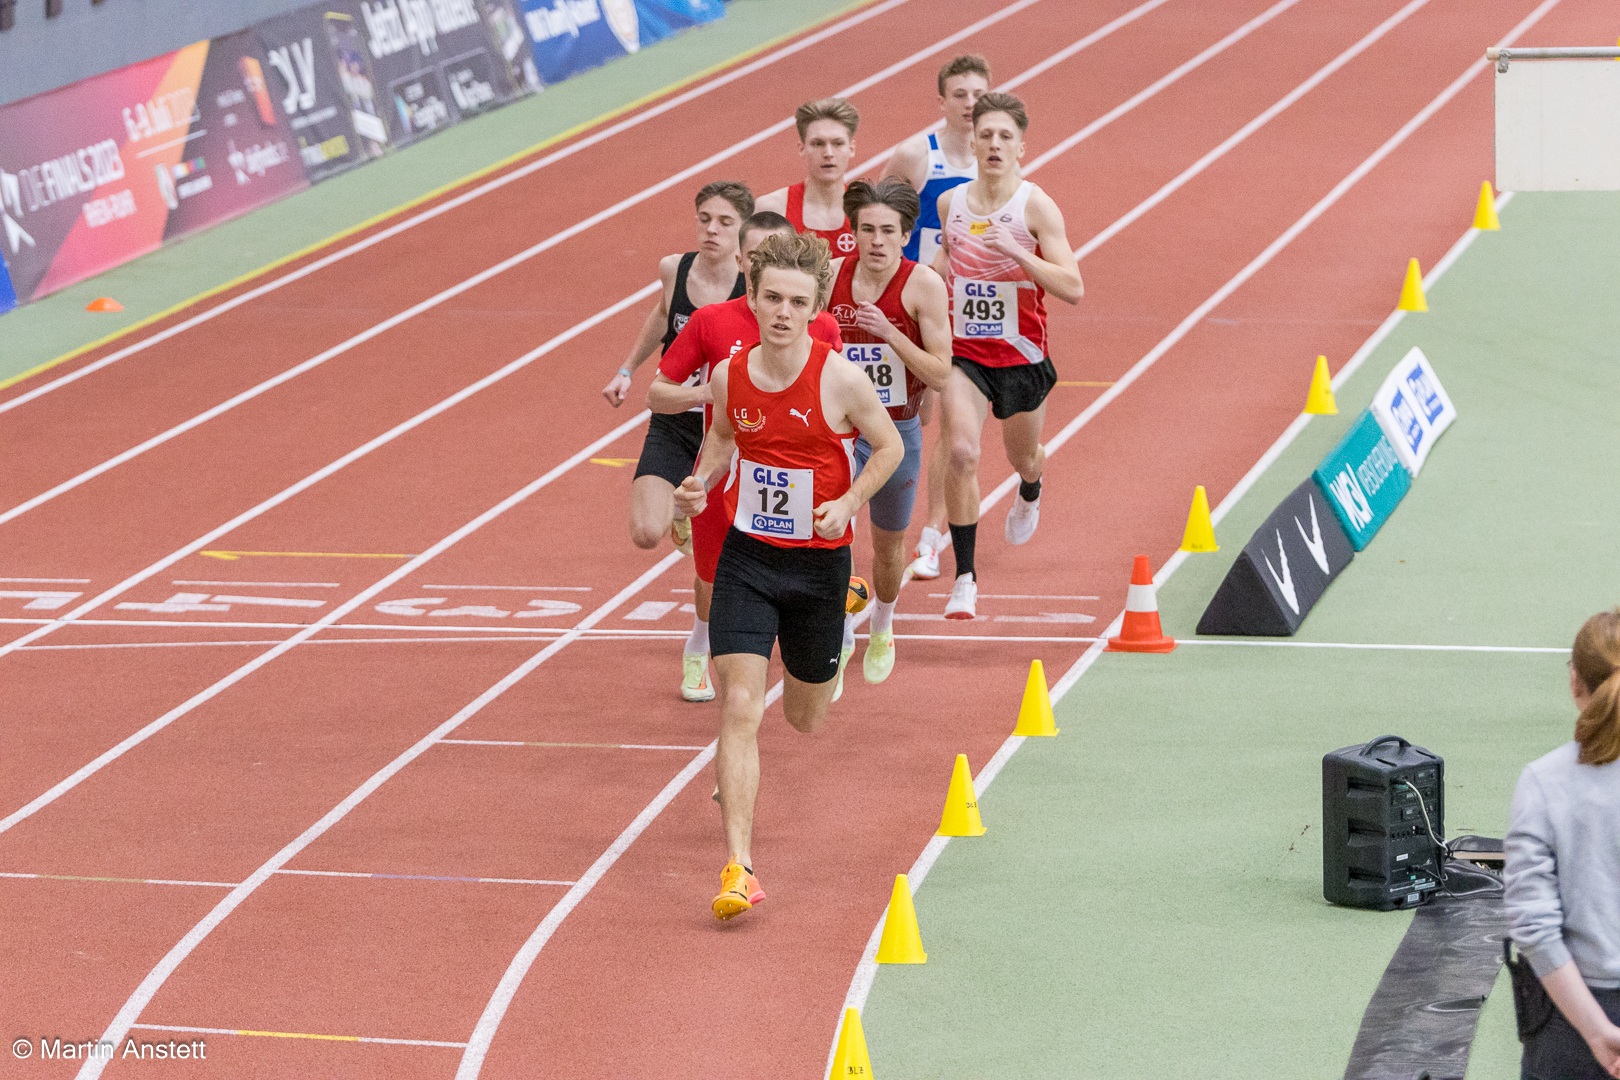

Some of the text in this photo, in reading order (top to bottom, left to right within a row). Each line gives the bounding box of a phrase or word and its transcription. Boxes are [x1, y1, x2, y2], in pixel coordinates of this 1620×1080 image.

[41, 149, 97, 201] FINALS
[962, 299, 1006, 321] 493
[864, 364, 893, 387] 48
[758, 487, 789, 515] 12
[768, 519, 793, 530] PLAN
